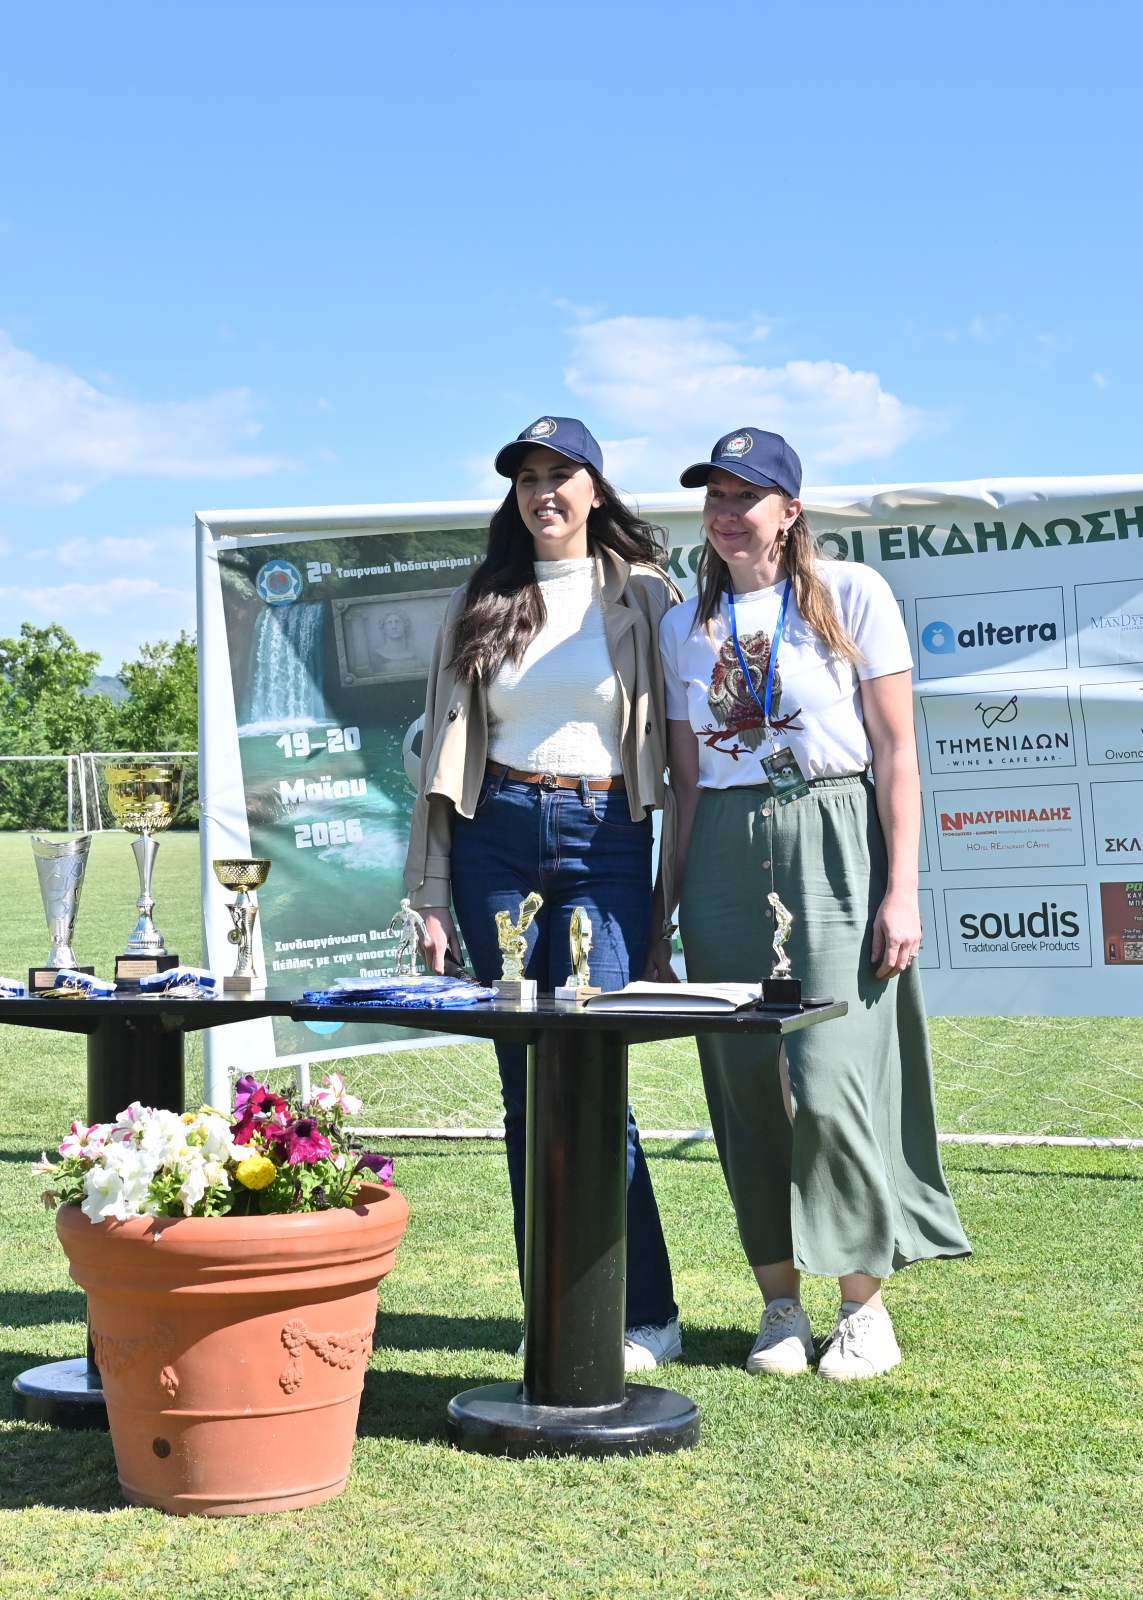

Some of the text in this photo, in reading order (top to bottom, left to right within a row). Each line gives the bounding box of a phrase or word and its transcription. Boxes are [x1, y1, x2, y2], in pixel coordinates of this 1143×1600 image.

[336, 563, 391, 578] Τουρνουά
[393, 557, 471, 572] Ποδοσφαίρου
[957, 621, 1057, 648] alterra
[936, 733, 1069, 755] ΤΗΜΕΝΙΔΩΝ
[1001, 756, 1028, 764] CAFE
[294, 818, 364, 849] 2026
[1105, 837, 1142, 852] ΣΚΛ
[960, 902, 1080, 939] soudis
[963, 941, 1080, 953] Traditional Greek Products
[272, 957, 314, 971] Πέλλας
[316, 956, 330, 968] με
[333, 953, 353, 965] την
